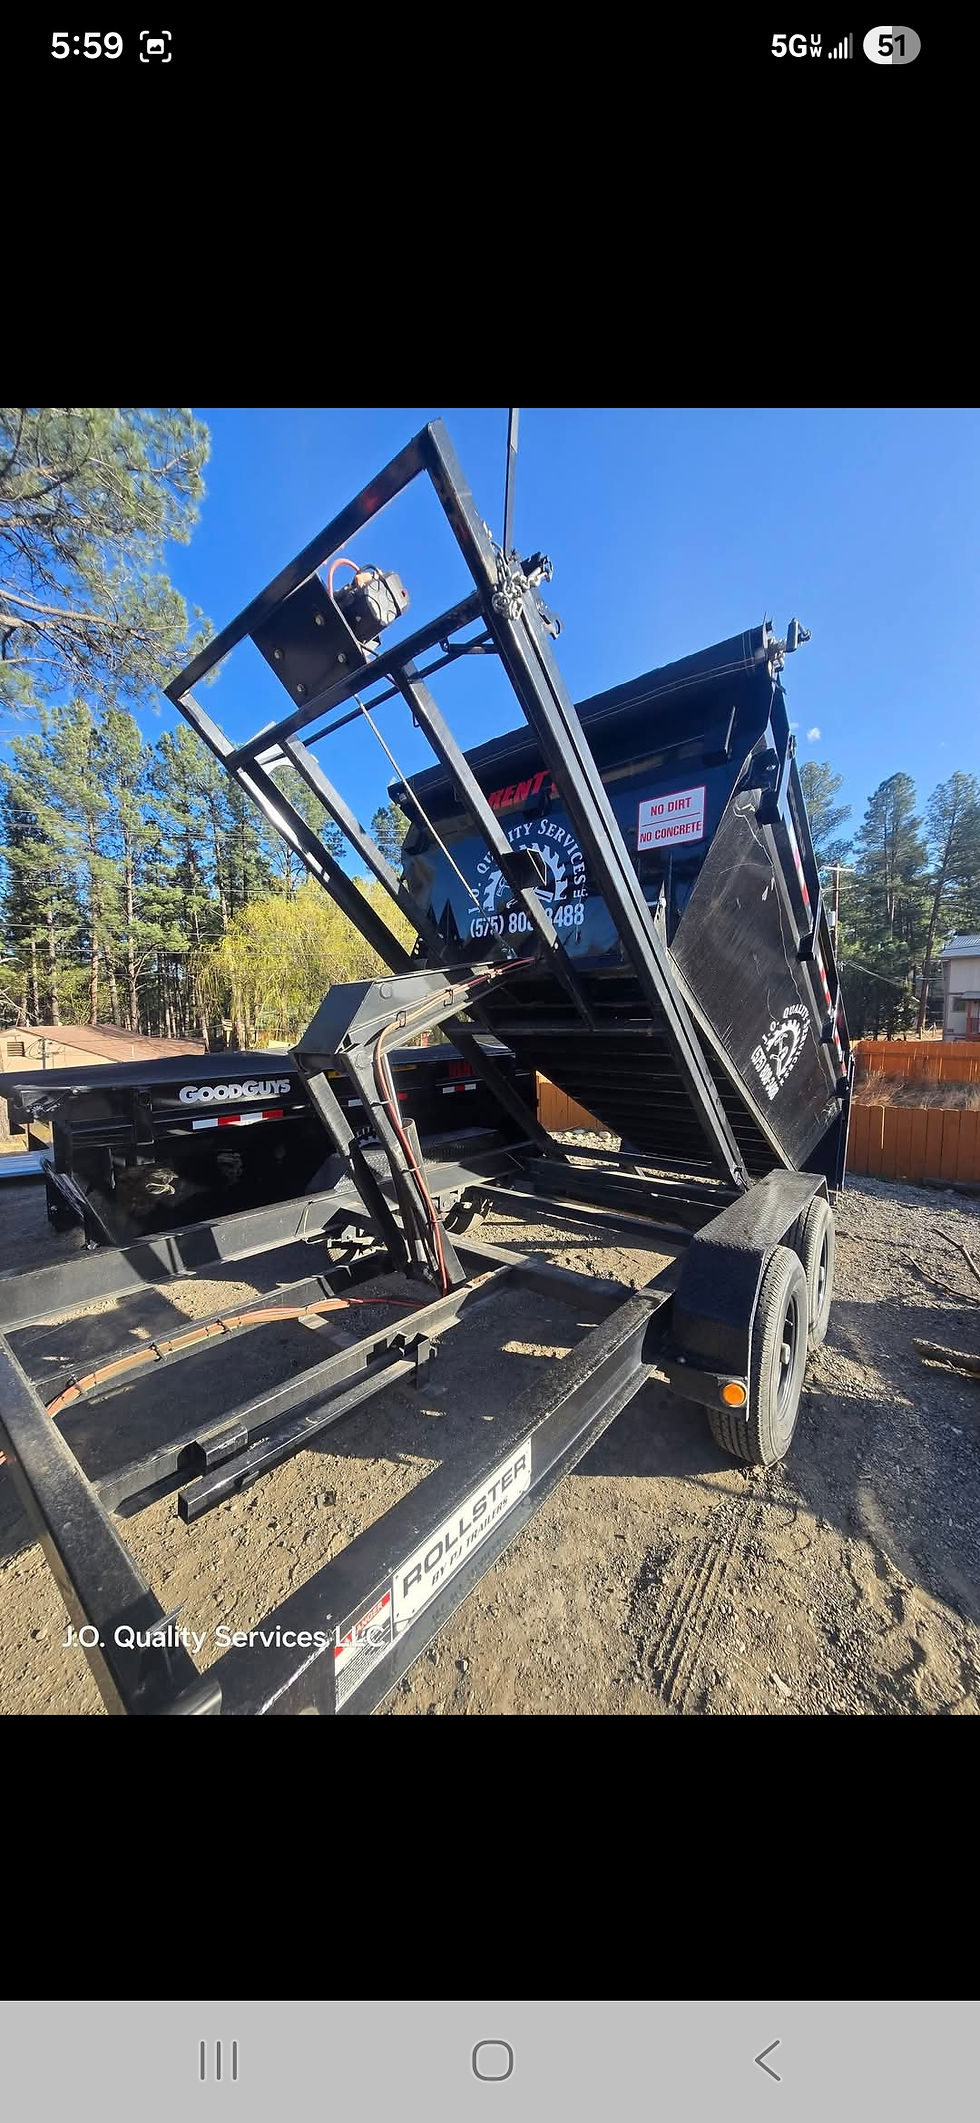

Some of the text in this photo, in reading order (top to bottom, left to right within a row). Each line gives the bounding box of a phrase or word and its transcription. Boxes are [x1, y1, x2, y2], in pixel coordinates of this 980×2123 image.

[650, 797, 692, 816] NO DIRT
[640, 820, 702, 843] NO CONCRETE
[538, 818, 587, 885] SERVICES
[470, 914, 505, 938] (575)
[782, 1004, 809, 1021] QUALITY
[179, 1079, 291, 1104] GOODGUYS
[403, 1453, 526, 1598] ROLLSTER
[432, 1562, 447, 1586] BY
[467, 1496, 508, 1547] TRAILERS
